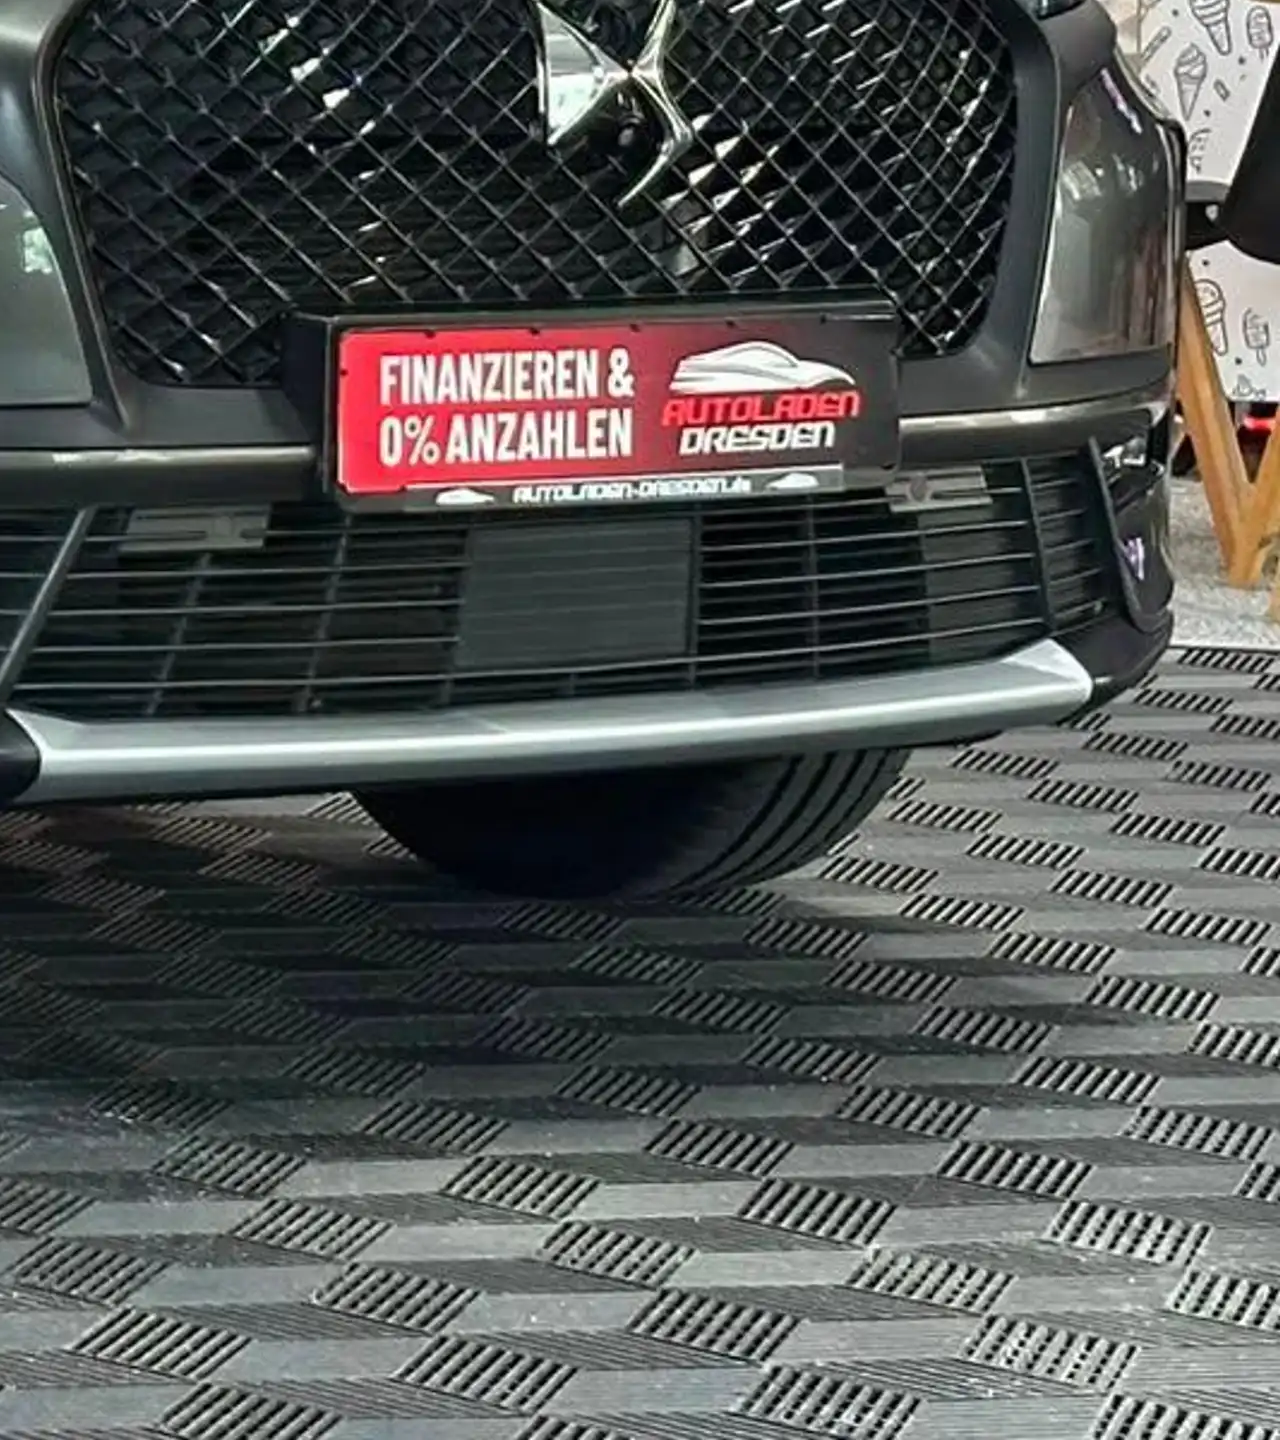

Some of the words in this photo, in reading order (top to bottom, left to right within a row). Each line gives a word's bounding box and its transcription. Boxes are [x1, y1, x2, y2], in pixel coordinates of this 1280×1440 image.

[380, 349, 599, 405] FINANZIEREN
[607, 347, 635, 398] &
[661, 391, 860, 427] AUTOLADEN
[678, 419, 837, 457] DRESDEN
